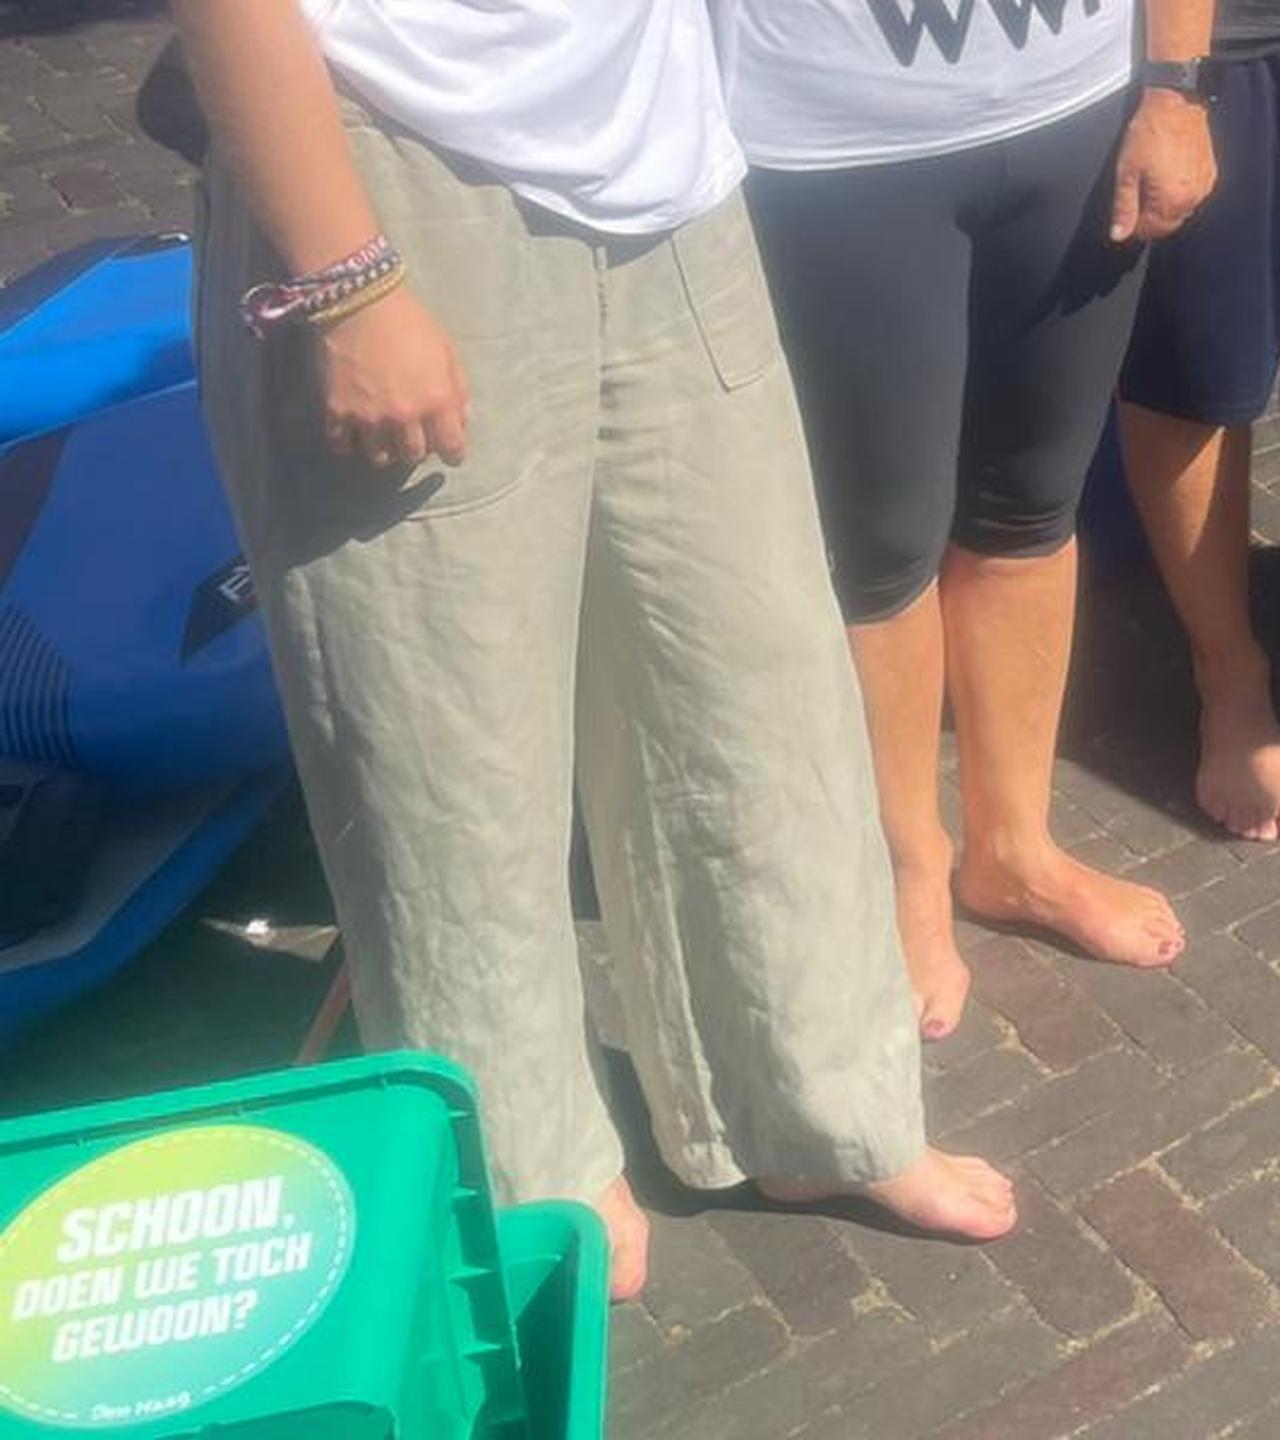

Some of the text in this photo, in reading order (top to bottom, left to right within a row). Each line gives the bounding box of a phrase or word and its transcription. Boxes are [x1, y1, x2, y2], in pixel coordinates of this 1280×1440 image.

[57, 1174, 297, 1263] SCHOON,
[12, 1232, 313, 1322] DOEN WE TOCH
[53, 1289, 258, 1363] GEWOON?
